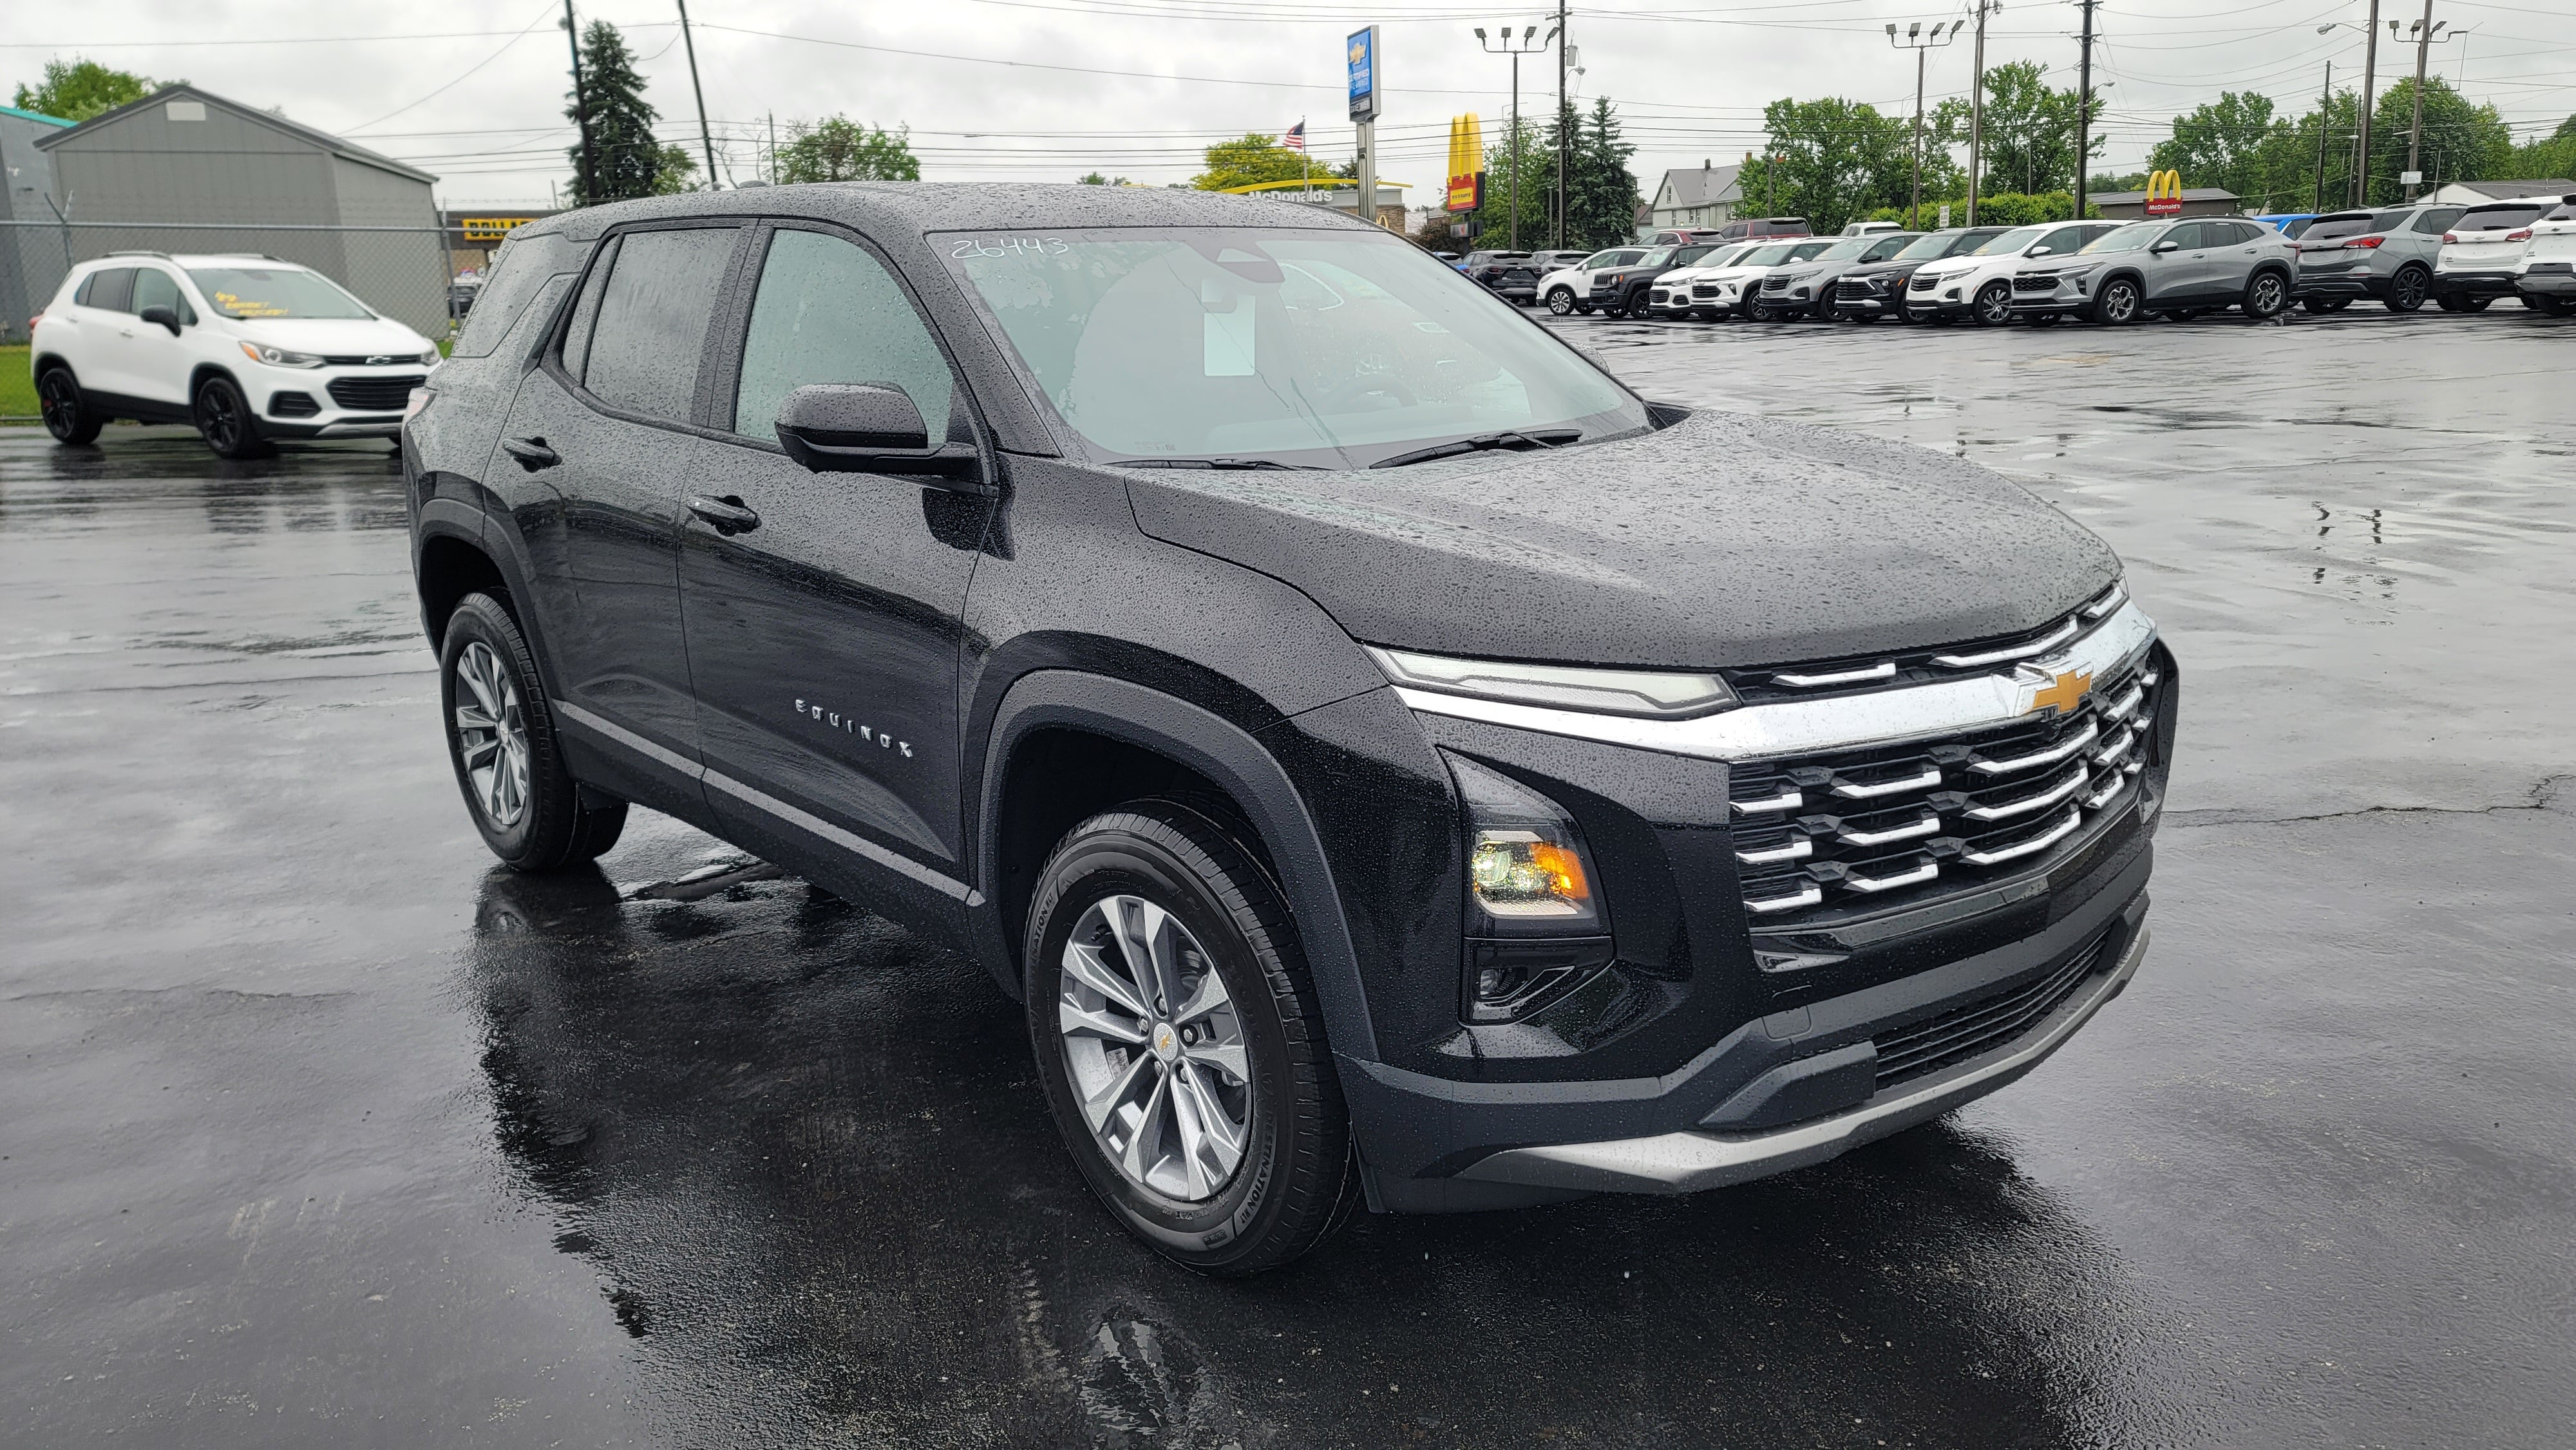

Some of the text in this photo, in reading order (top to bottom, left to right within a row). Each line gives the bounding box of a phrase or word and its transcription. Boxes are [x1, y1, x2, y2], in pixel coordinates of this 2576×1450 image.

[1248, 185, 1333, 202] McDonald's
[468, 221, 529, 237] DOLL
[951, 238, 1069, 258] 26443
[795, 699, 913, 757] EQUINOX
[1247, 1109, 1273, 1211] DESTINATION
